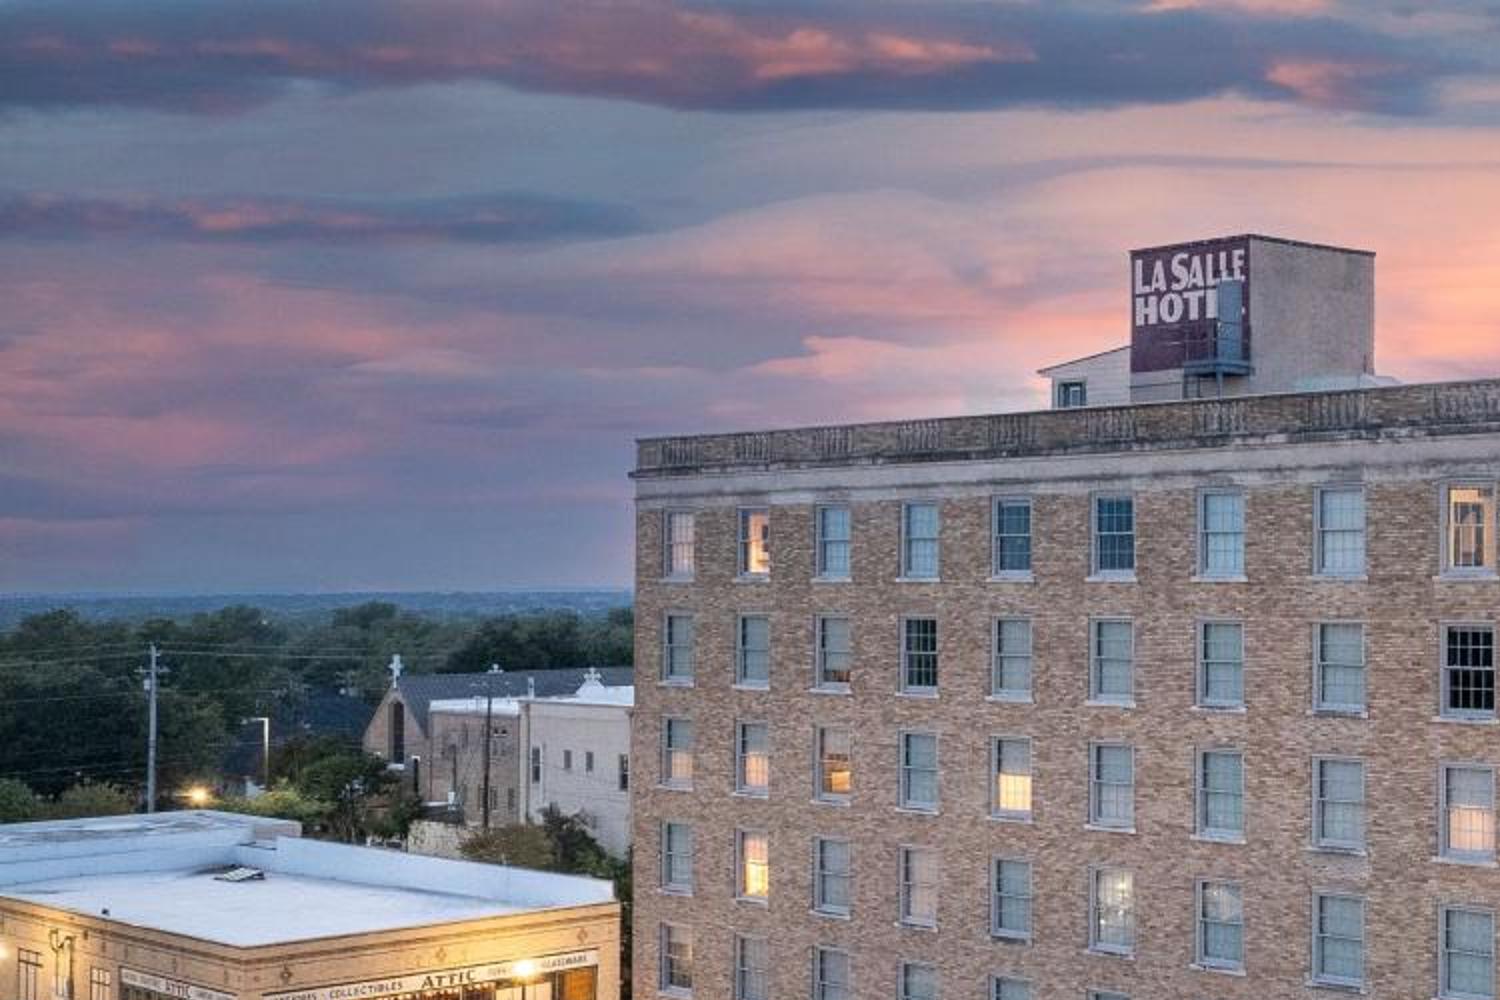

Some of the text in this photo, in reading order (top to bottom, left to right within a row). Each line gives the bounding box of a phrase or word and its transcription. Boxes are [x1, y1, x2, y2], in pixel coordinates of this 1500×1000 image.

[1135, 289, 1246, 327] HOTE
[329, 982, 403, 999] COLLECTIBLES
[421, 969, 478, 989] ATTIC
